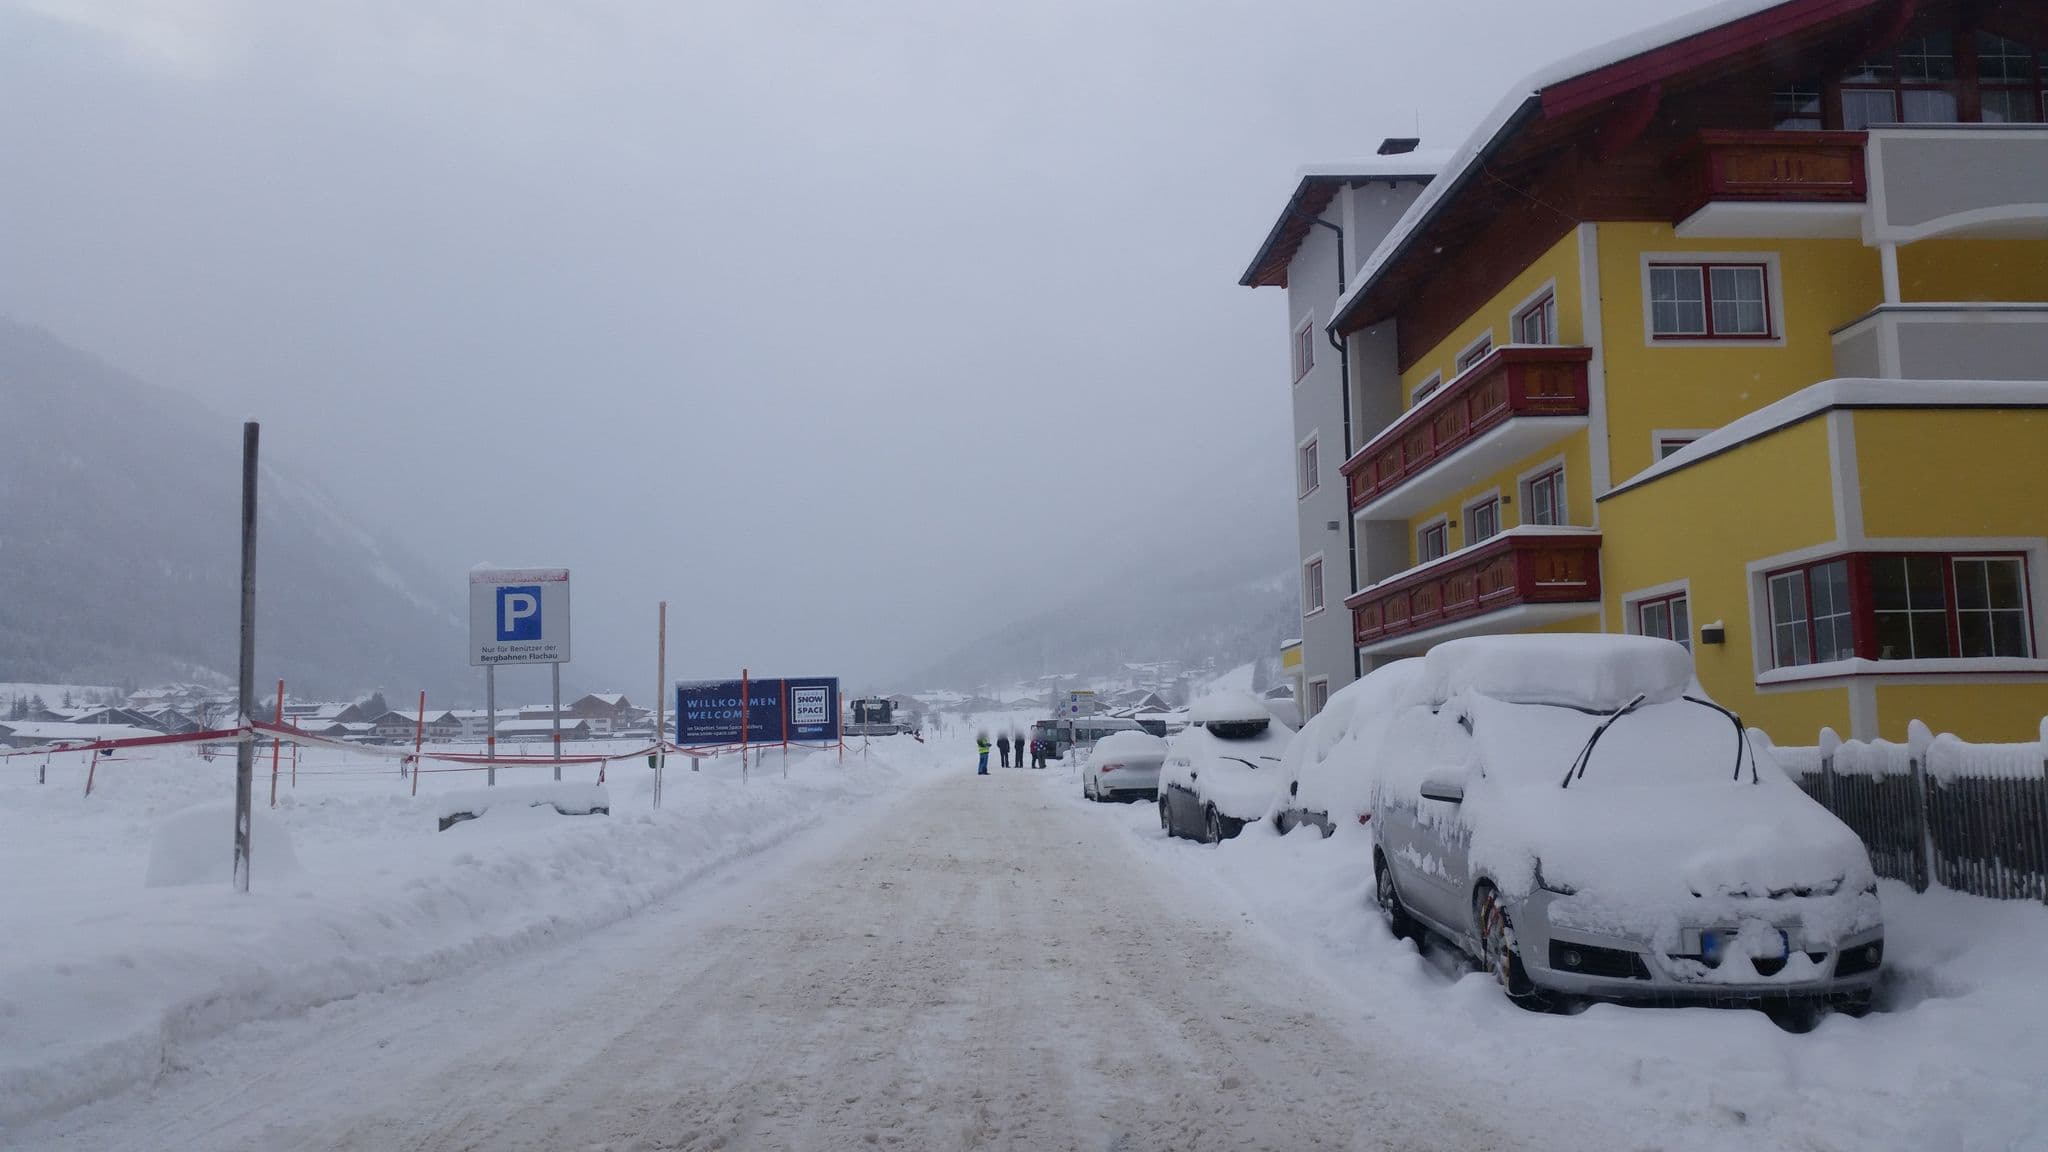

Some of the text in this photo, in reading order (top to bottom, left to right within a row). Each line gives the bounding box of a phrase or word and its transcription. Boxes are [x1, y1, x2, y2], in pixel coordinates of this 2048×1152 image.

[504, 593, 537, 632] P
[481, 654, 527, 662] Bergbahnen
[797, 706, 824, 714] SPACE
